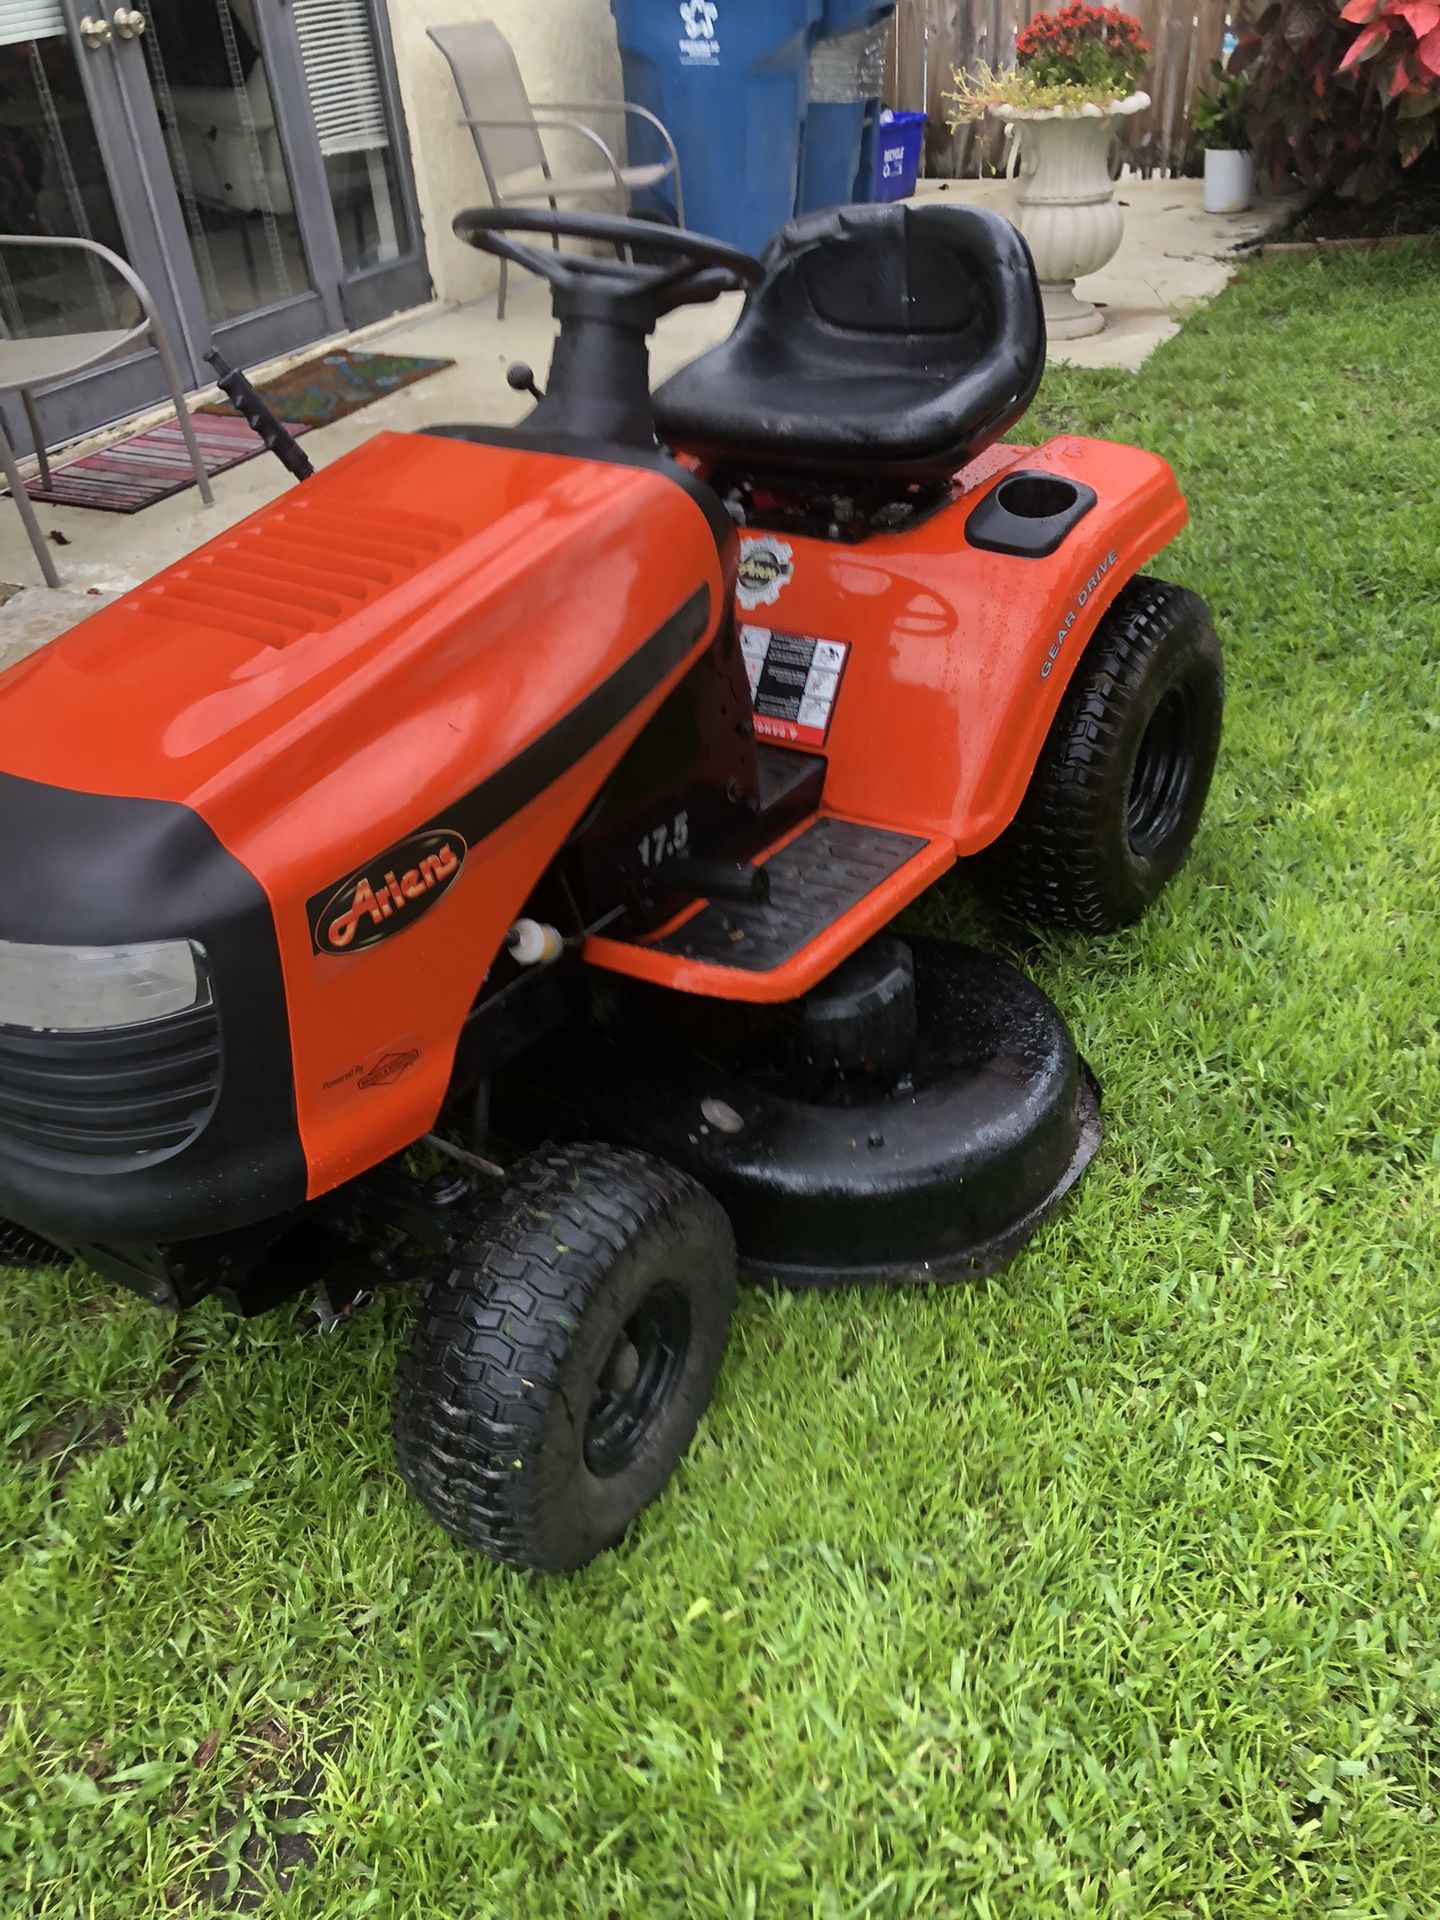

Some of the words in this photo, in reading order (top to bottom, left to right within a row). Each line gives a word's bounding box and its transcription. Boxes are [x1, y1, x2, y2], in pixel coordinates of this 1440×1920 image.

[1041, 610, 1076, 679] GEAR
[1078, 549, 1117, 607] DRIVE
[638, 810, 688, 867] 17.5
[328, 842, 458, 947] Ariens
[323, 1069, 354, 1091] Powered
[355, 1064, 364, 1075] By
